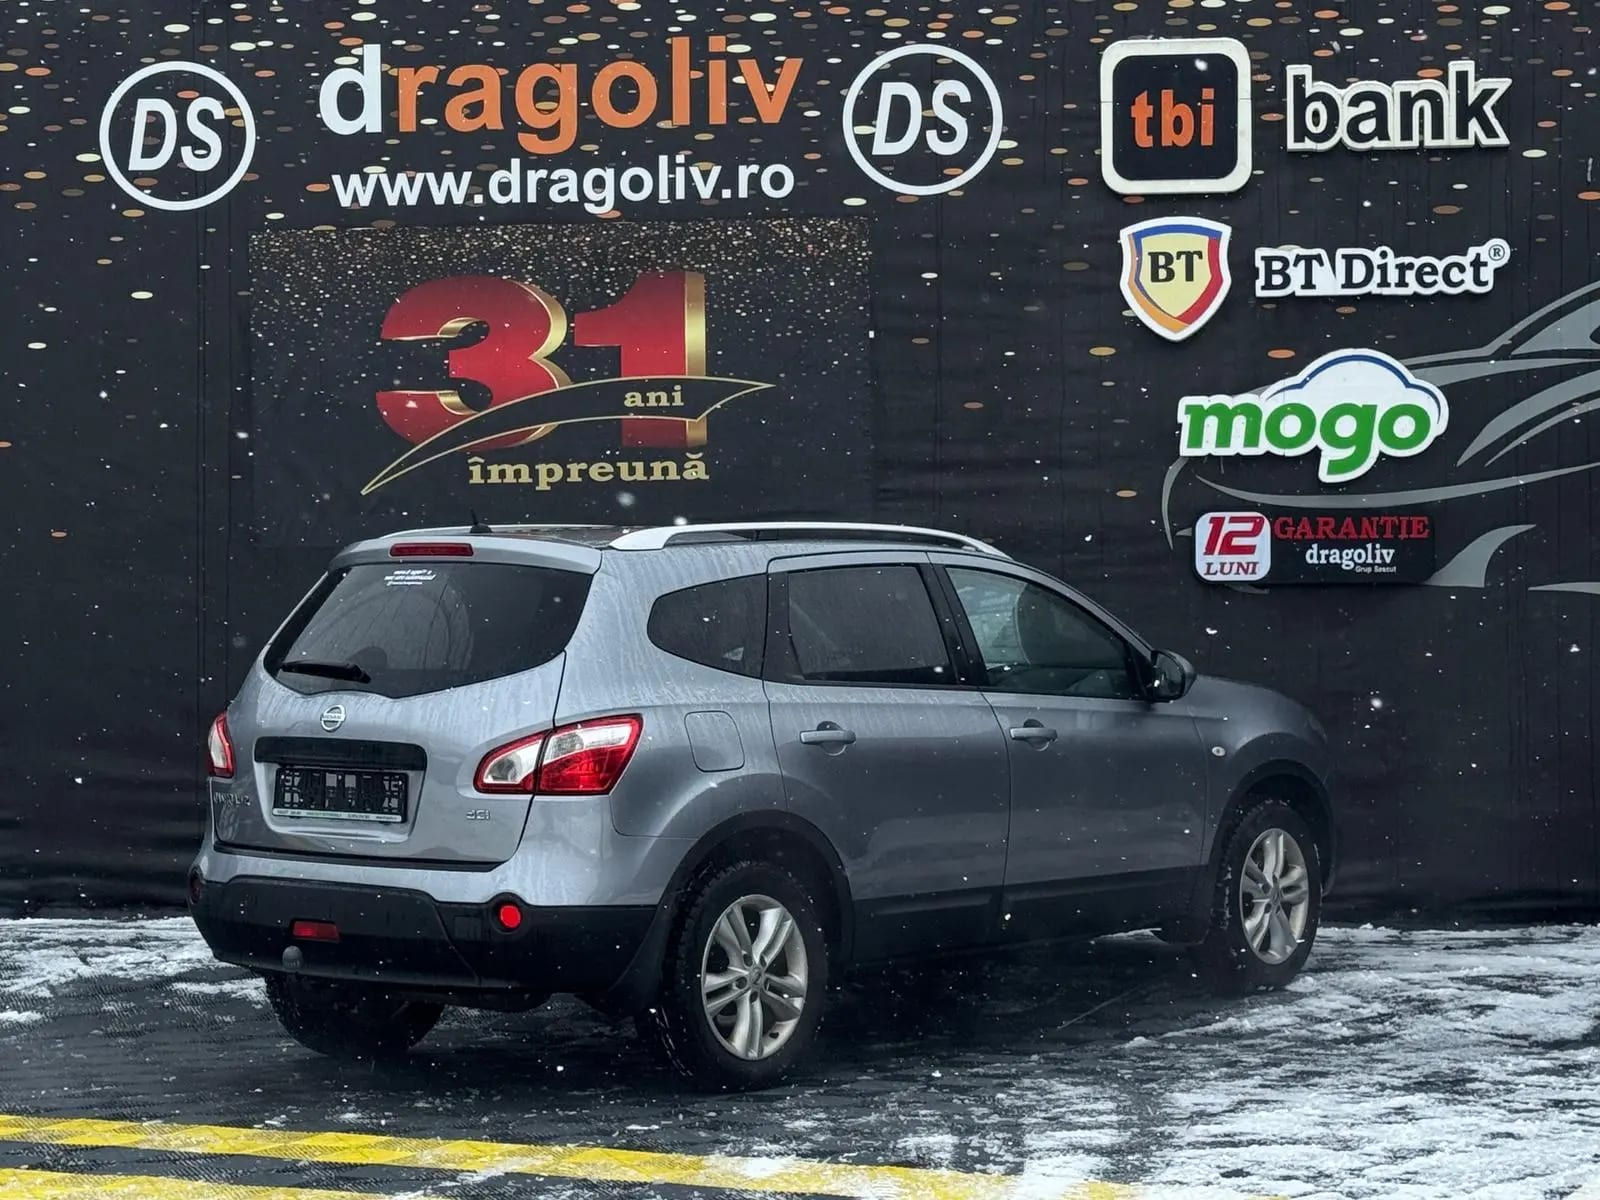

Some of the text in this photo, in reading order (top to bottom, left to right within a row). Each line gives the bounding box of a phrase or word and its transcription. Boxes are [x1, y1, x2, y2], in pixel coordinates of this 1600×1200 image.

[319, 36, 804, 155] dragoliv
[1130, 69, 1501, 148] tbi bank
[128, 96, 225, 172] DS
[872, 79, 972, 156] DS
[331, 154, 795, 214] www.dragoliv.ro
[1148, 250, 1203, 283] BT
[1261, 254, 1325, 291] BT
[375, 270, 708, 450] 31
[624, 384, 685, 408] ani
[1184, 402, 1431, 476] mogo
[468, 452, 710, 491] împreună
[1203, 516, 1264, 556] 12
[1273, 515, 1430, 540] GARANTIE
[1203, 561, 1259, 576] LUNI
[1305, 543, 1395, 570] dragoliv
